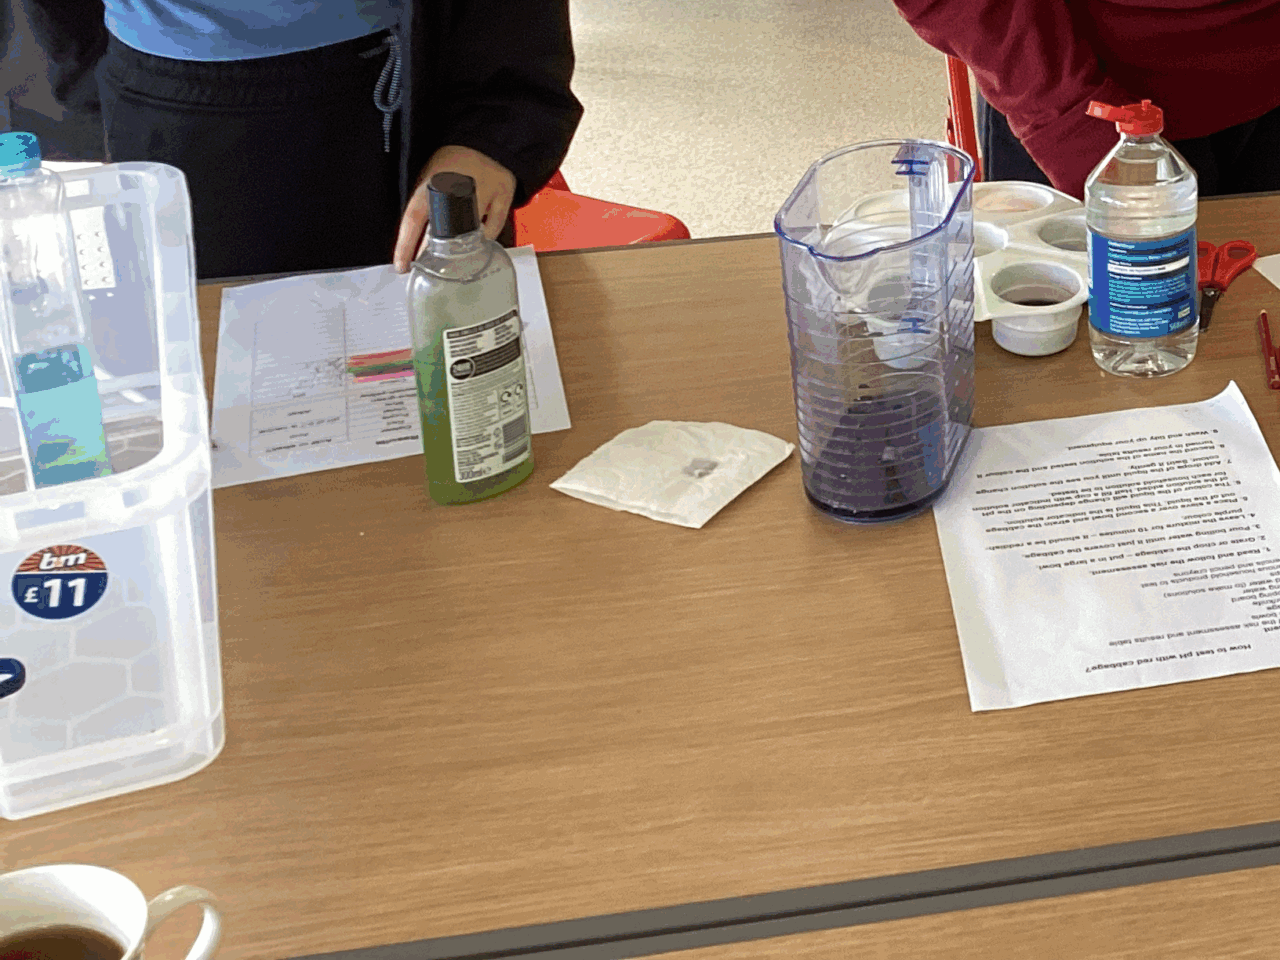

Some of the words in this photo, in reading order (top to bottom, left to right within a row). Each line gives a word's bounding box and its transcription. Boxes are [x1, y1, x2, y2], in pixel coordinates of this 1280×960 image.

[1213, 507, 1243, 516] purple
[1165, 520, 1200, 528] mixture
[1098, 528, 1135, 536] minutes
[1194, 527, 1227, 536] boiling
[1047, 535, 1080, 543] should
[985, 542, 1024, 551] reddish-
[1191, 541, 1216, 549] chop
[1133, 547, 1174, 557] cabbage
[39, 552, 86, 570] bm
[1062, 558, 1087, 566] large
[1186, 554, 1215, 562] follow
[1173, 567, 1207, 576] crayons
[1208, 563, 1235, 572] pencil
[1209, 568, 1256, 578] household
[1169, 574, 1208, 584] products
[24, 578, 86, 608] £11
[1163, 587, 1206, 597] solutions)
[1242, 586, 1267, 594] water
[1230, 594, 1257, 602] board
[1185, 624, 1241, 635] assessment
[1133, 634, 1165, 643] results
[1154, 654, 1177, 662] with
[1084, 659, 1134, 672] cabbage?
